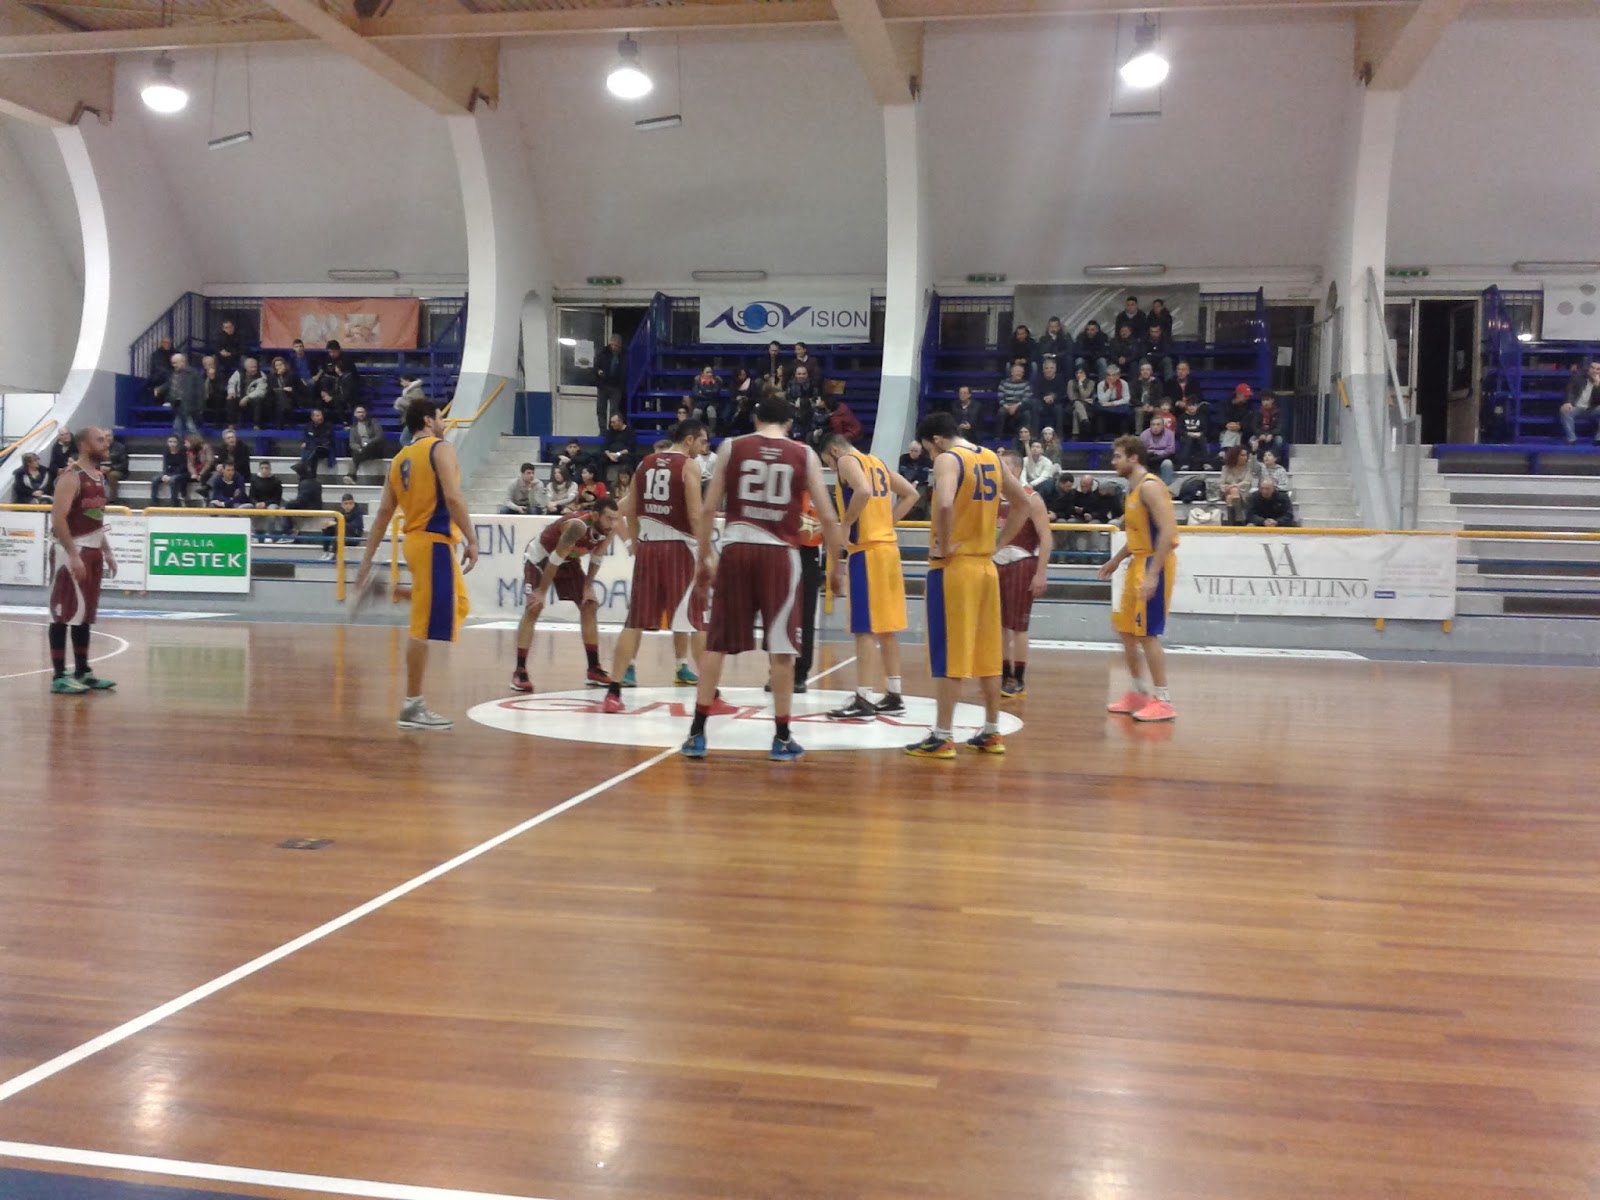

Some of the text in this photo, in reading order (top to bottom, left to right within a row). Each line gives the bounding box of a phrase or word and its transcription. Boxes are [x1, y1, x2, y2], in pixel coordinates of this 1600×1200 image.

[644, 468, 671, 501] 18
[739, 459, 794, 504] 20
[870, 467, 888, 496] 13
[972, 464, 997, 501] 15
[154, 539, 242, 568] FASTEK
[171, 539, 214, 548] ITALIA
[1193, 578, 1257, 596] VILLA
[1265, 579, 1368, 600] AVELLINO
